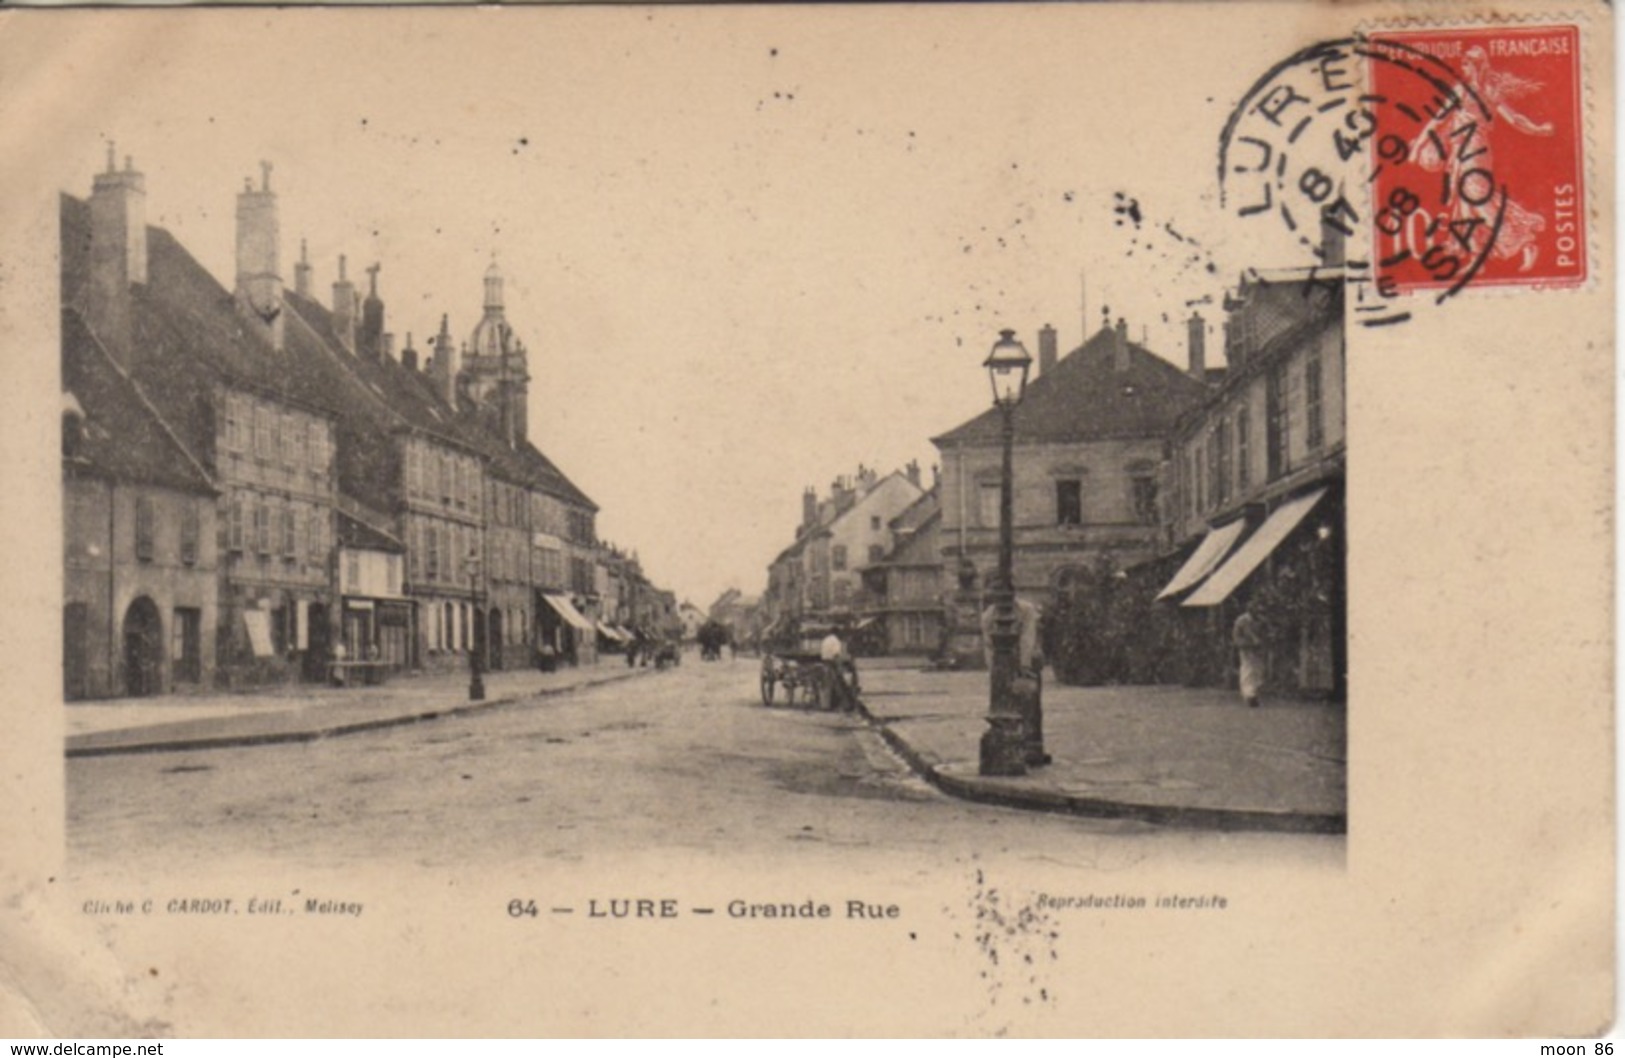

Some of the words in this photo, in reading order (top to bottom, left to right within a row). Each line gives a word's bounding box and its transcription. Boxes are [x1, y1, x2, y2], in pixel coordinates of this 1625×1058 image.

[1488, 36, 1570, 57] FRANÇAISE
[1234, 53, 1351, 217] LURE
[1553, 184, 1576, 268] POSTES
[507, 900, 539, 918] 64
[588, 900, 679, 918] LURE
[727, 899, 832, 919] Grande
[846, 900, 901, 918] Rue
